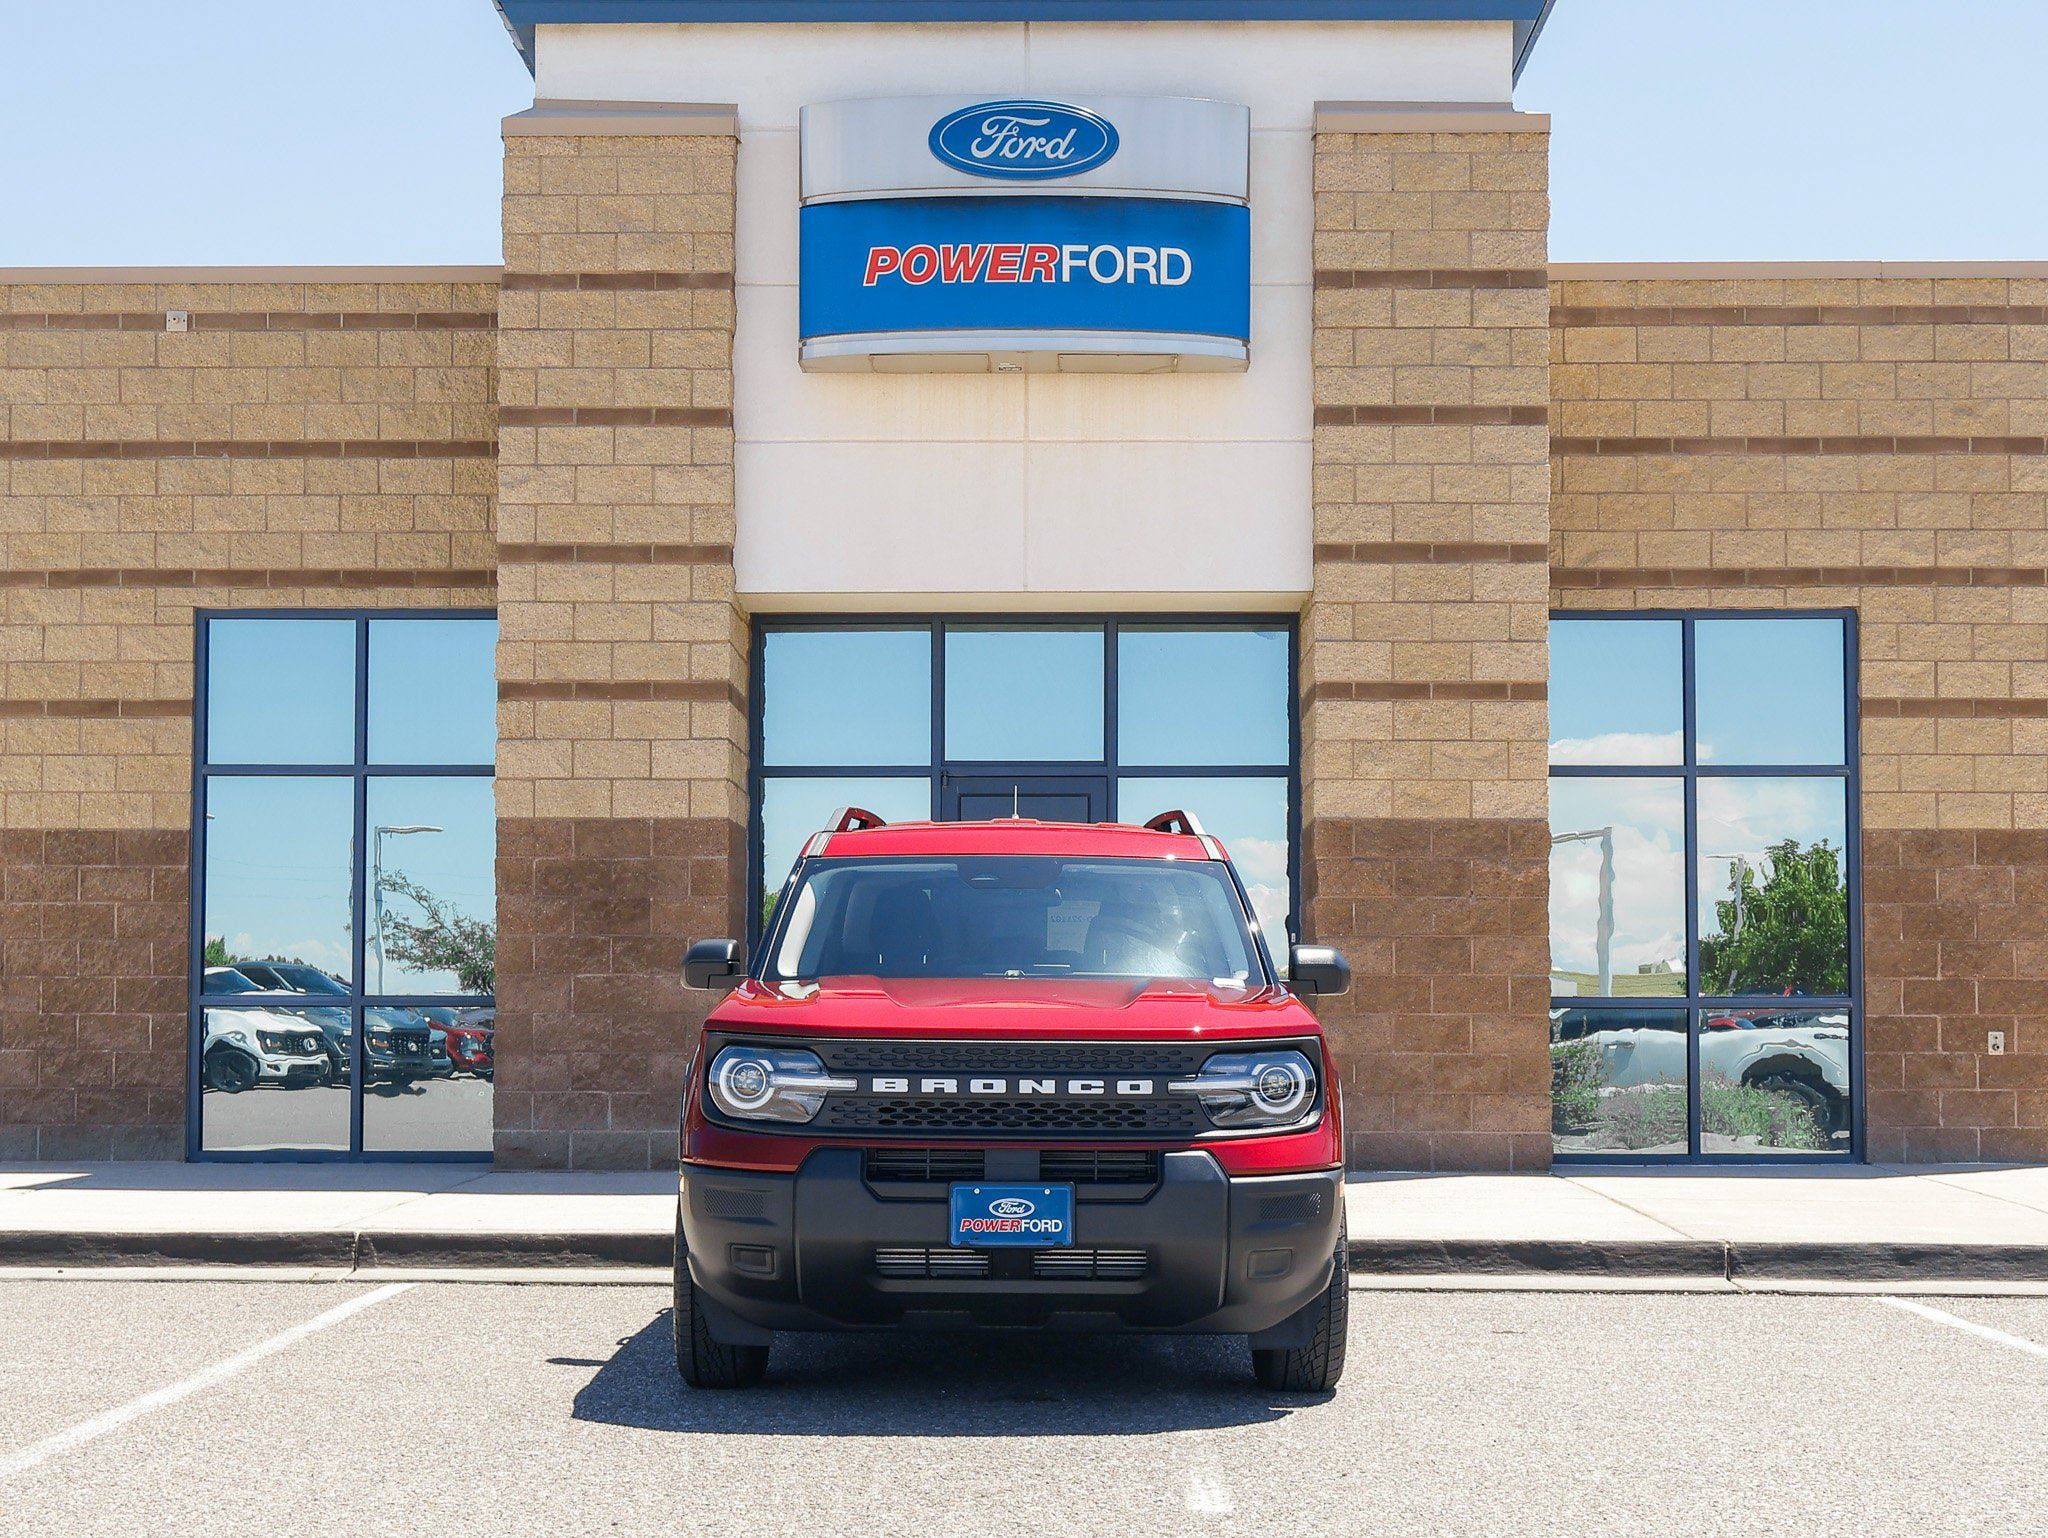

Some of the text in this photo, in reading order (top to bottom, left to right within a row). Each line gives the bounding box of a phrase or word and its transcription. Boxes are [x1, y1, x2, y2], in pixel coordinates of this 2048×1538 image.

[970, 115, 1078, 161] Ford
[863, 243, 1193, 287] POWERFORD
[872, 1077, 1154, 1095] BRONCO
[997, 1201, 1026, 1214] Ford
[960, 1219, 1063, 1233] POWERFORD
